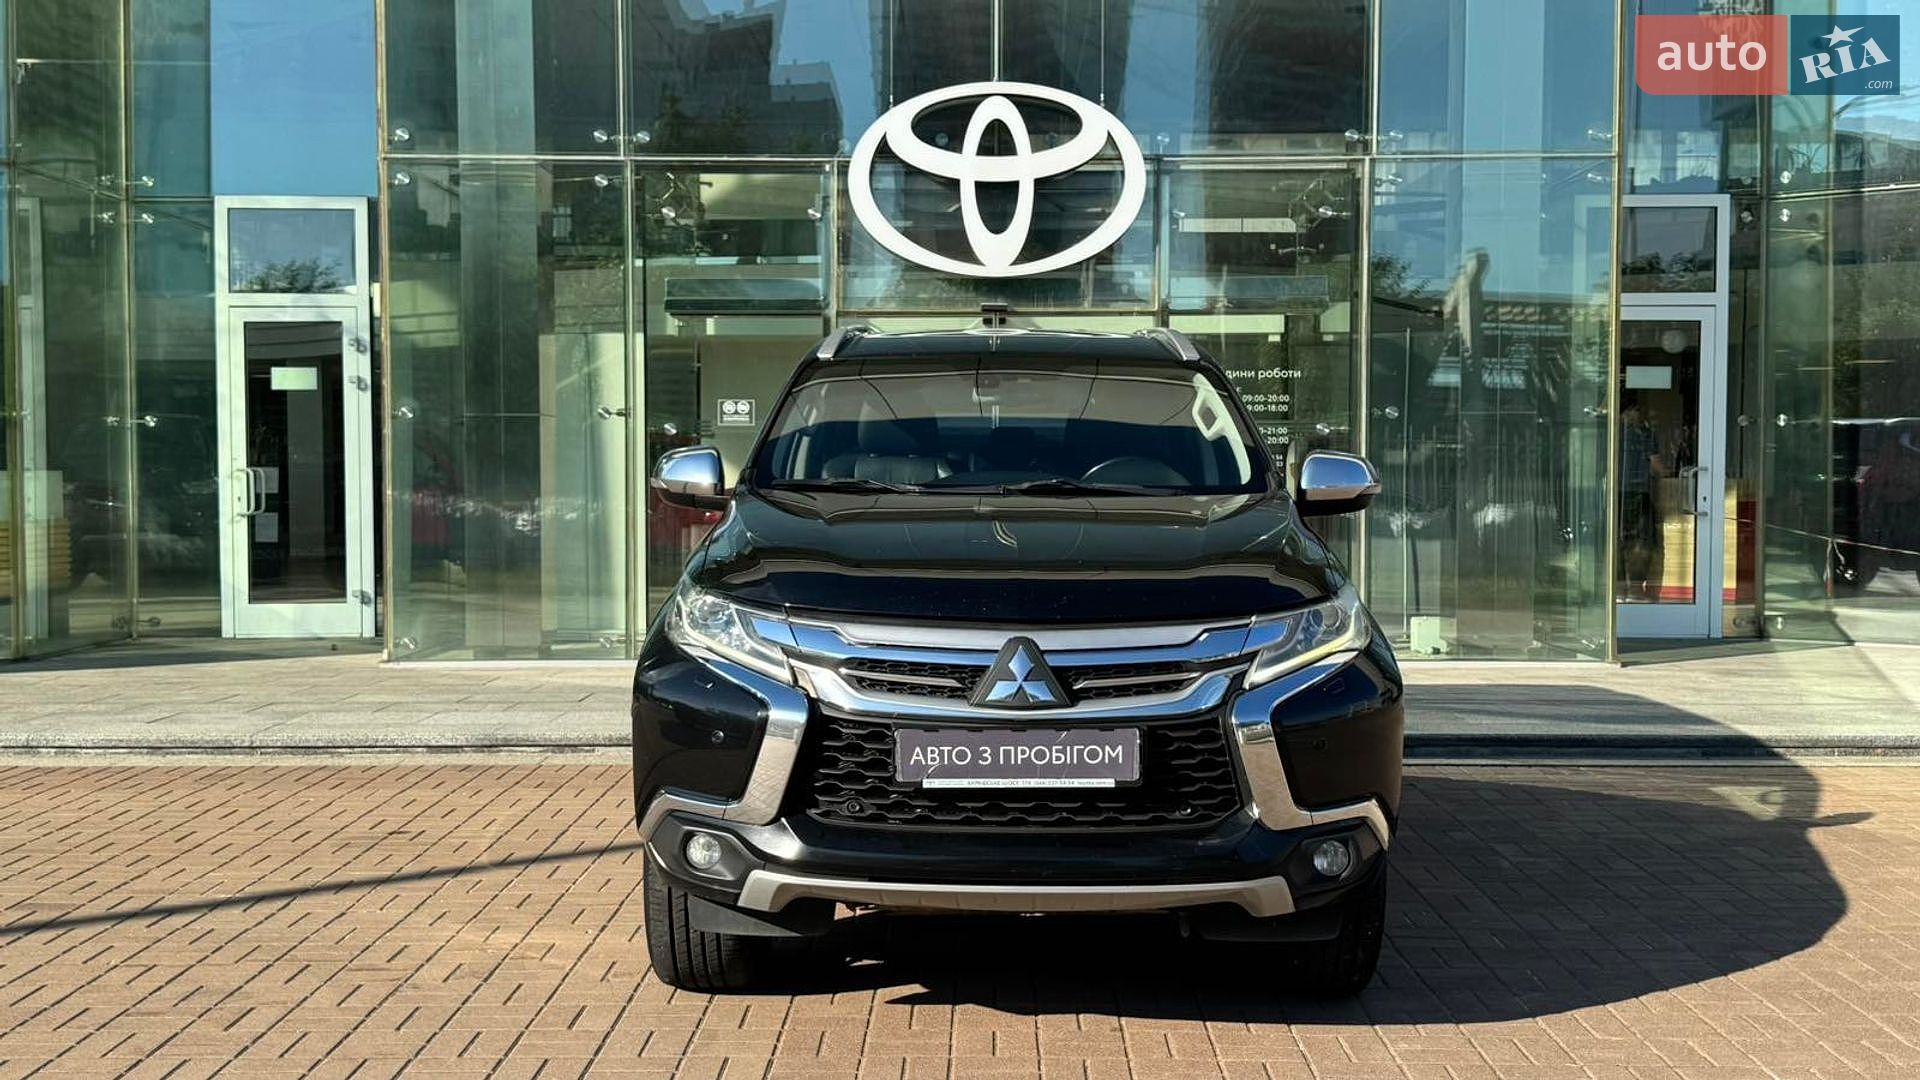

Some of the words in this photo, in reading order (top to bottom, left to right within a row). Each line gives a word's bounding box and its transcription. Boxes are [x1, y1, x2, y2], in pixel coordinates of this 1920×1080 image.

[1225, 369, 1255, 379] дини
[1258, 367, 1301, 380] роботи
[1246, 404, 1289, 412] 9:00-18:00
[909, 746, 971, 765] АВТО
[978, 746, 992, 765] З
[1000, 745, 1122, 765] ПРОБІГОМ
